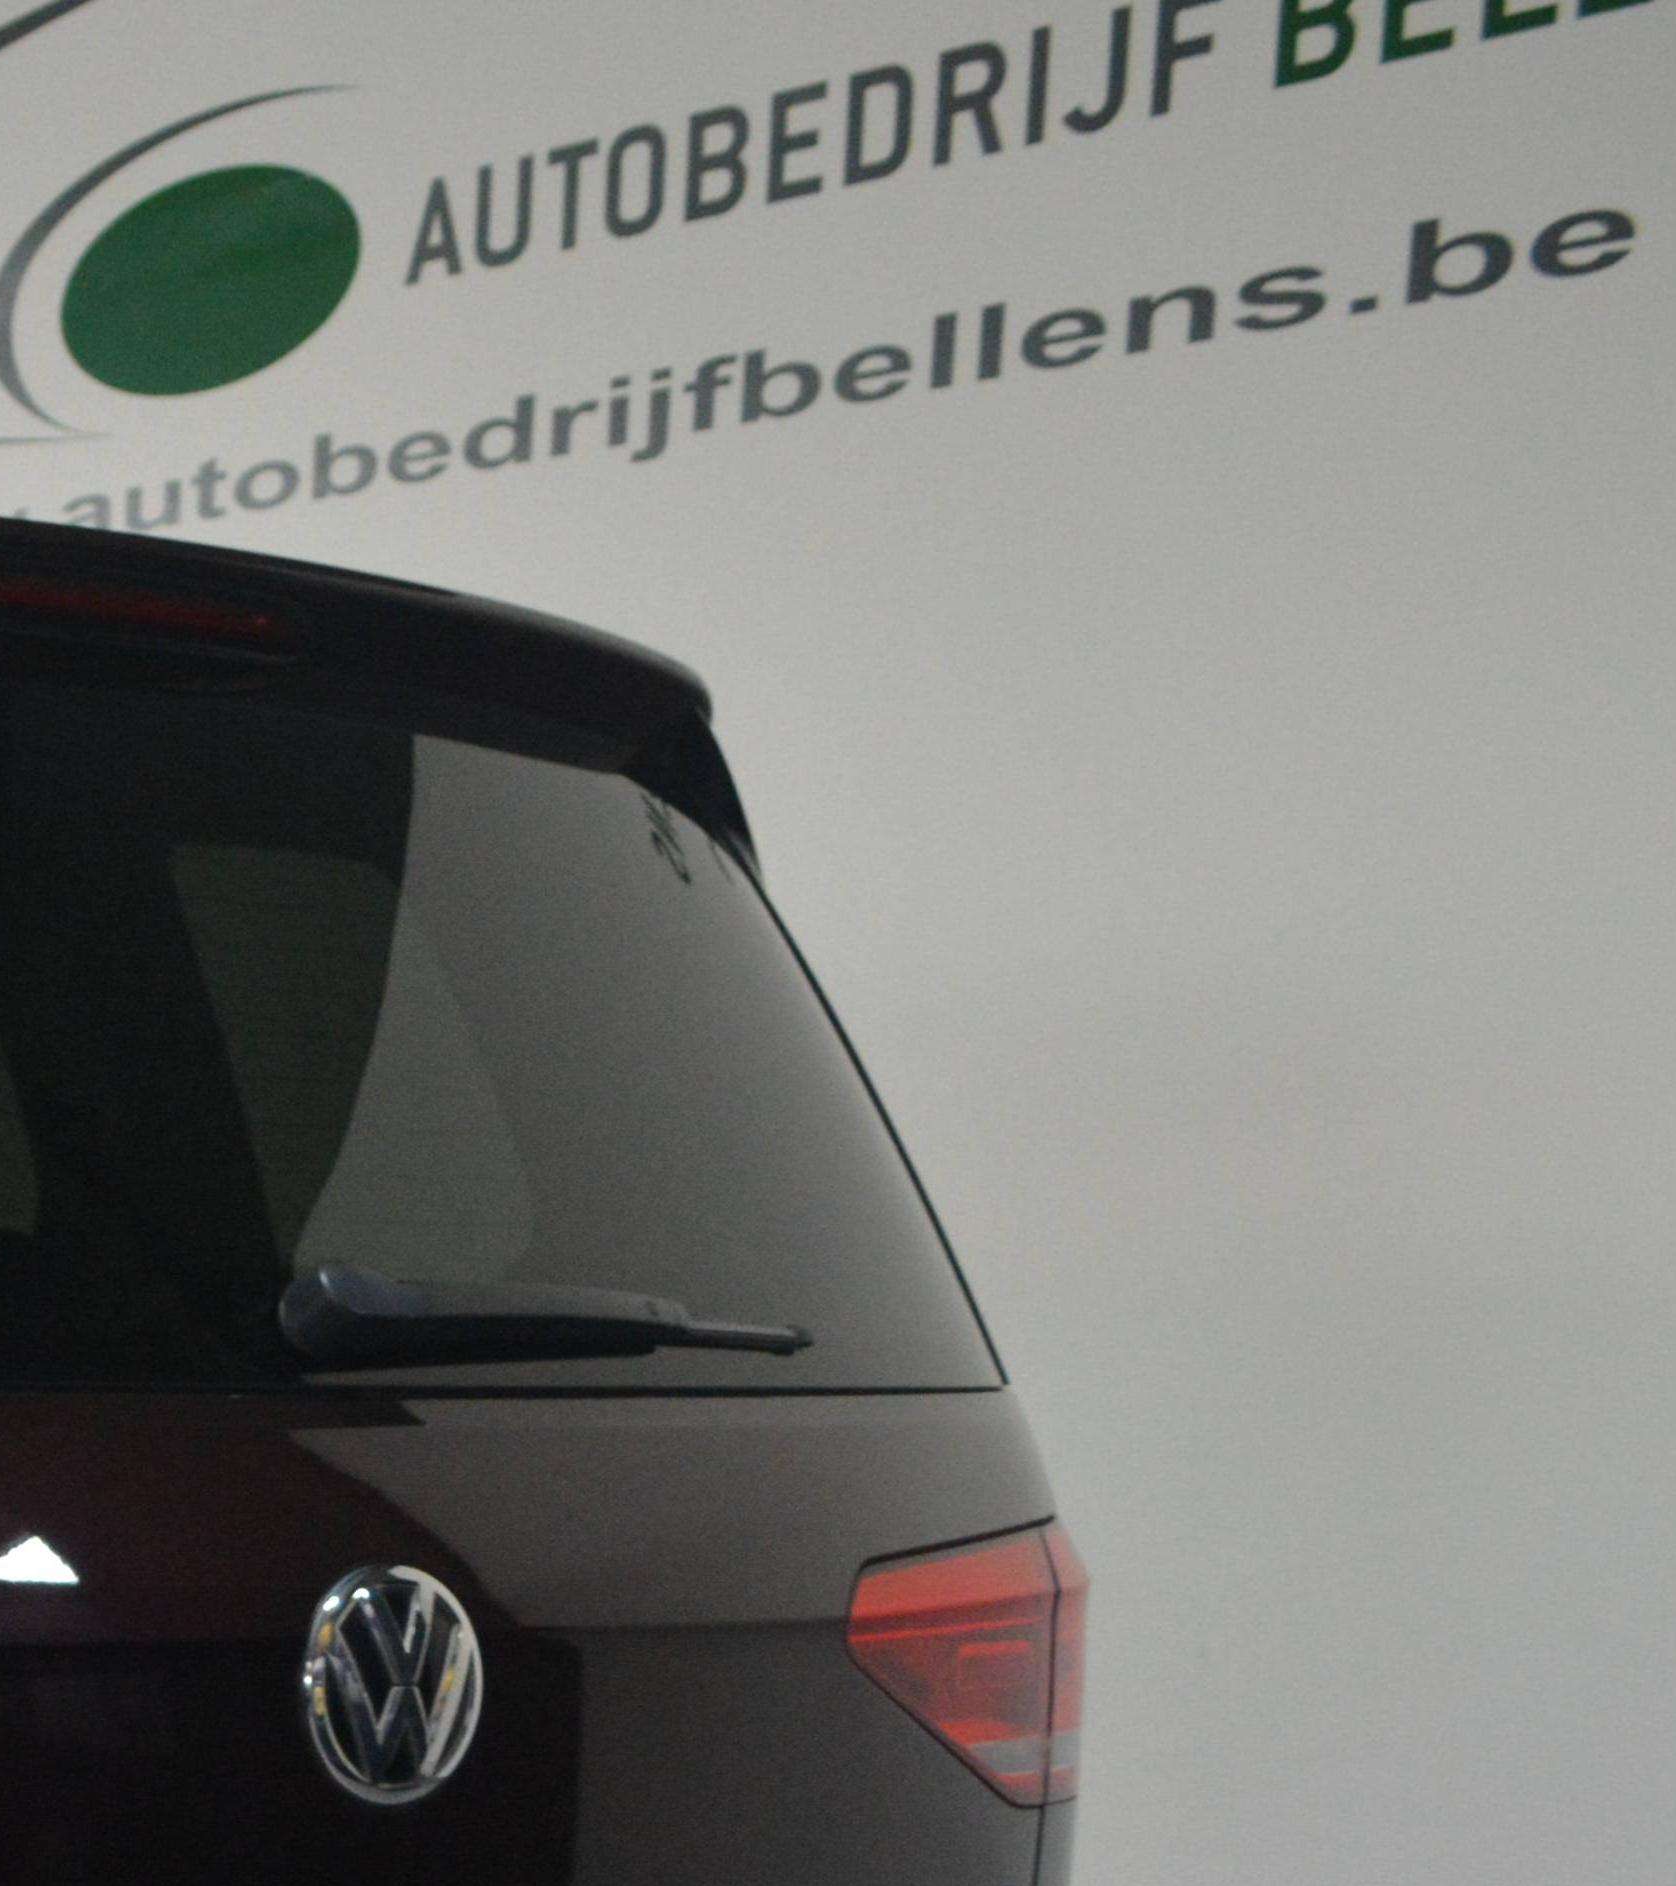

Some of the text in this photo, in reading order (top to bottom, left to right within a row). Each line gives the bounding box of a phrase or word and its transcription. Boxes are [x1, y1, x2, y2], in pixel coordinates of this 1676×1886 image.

[404, 0, 1652, 286] AUTOBEDRIJF BE
[61, 208, 1636, 531] autobedrijfbellens.be
